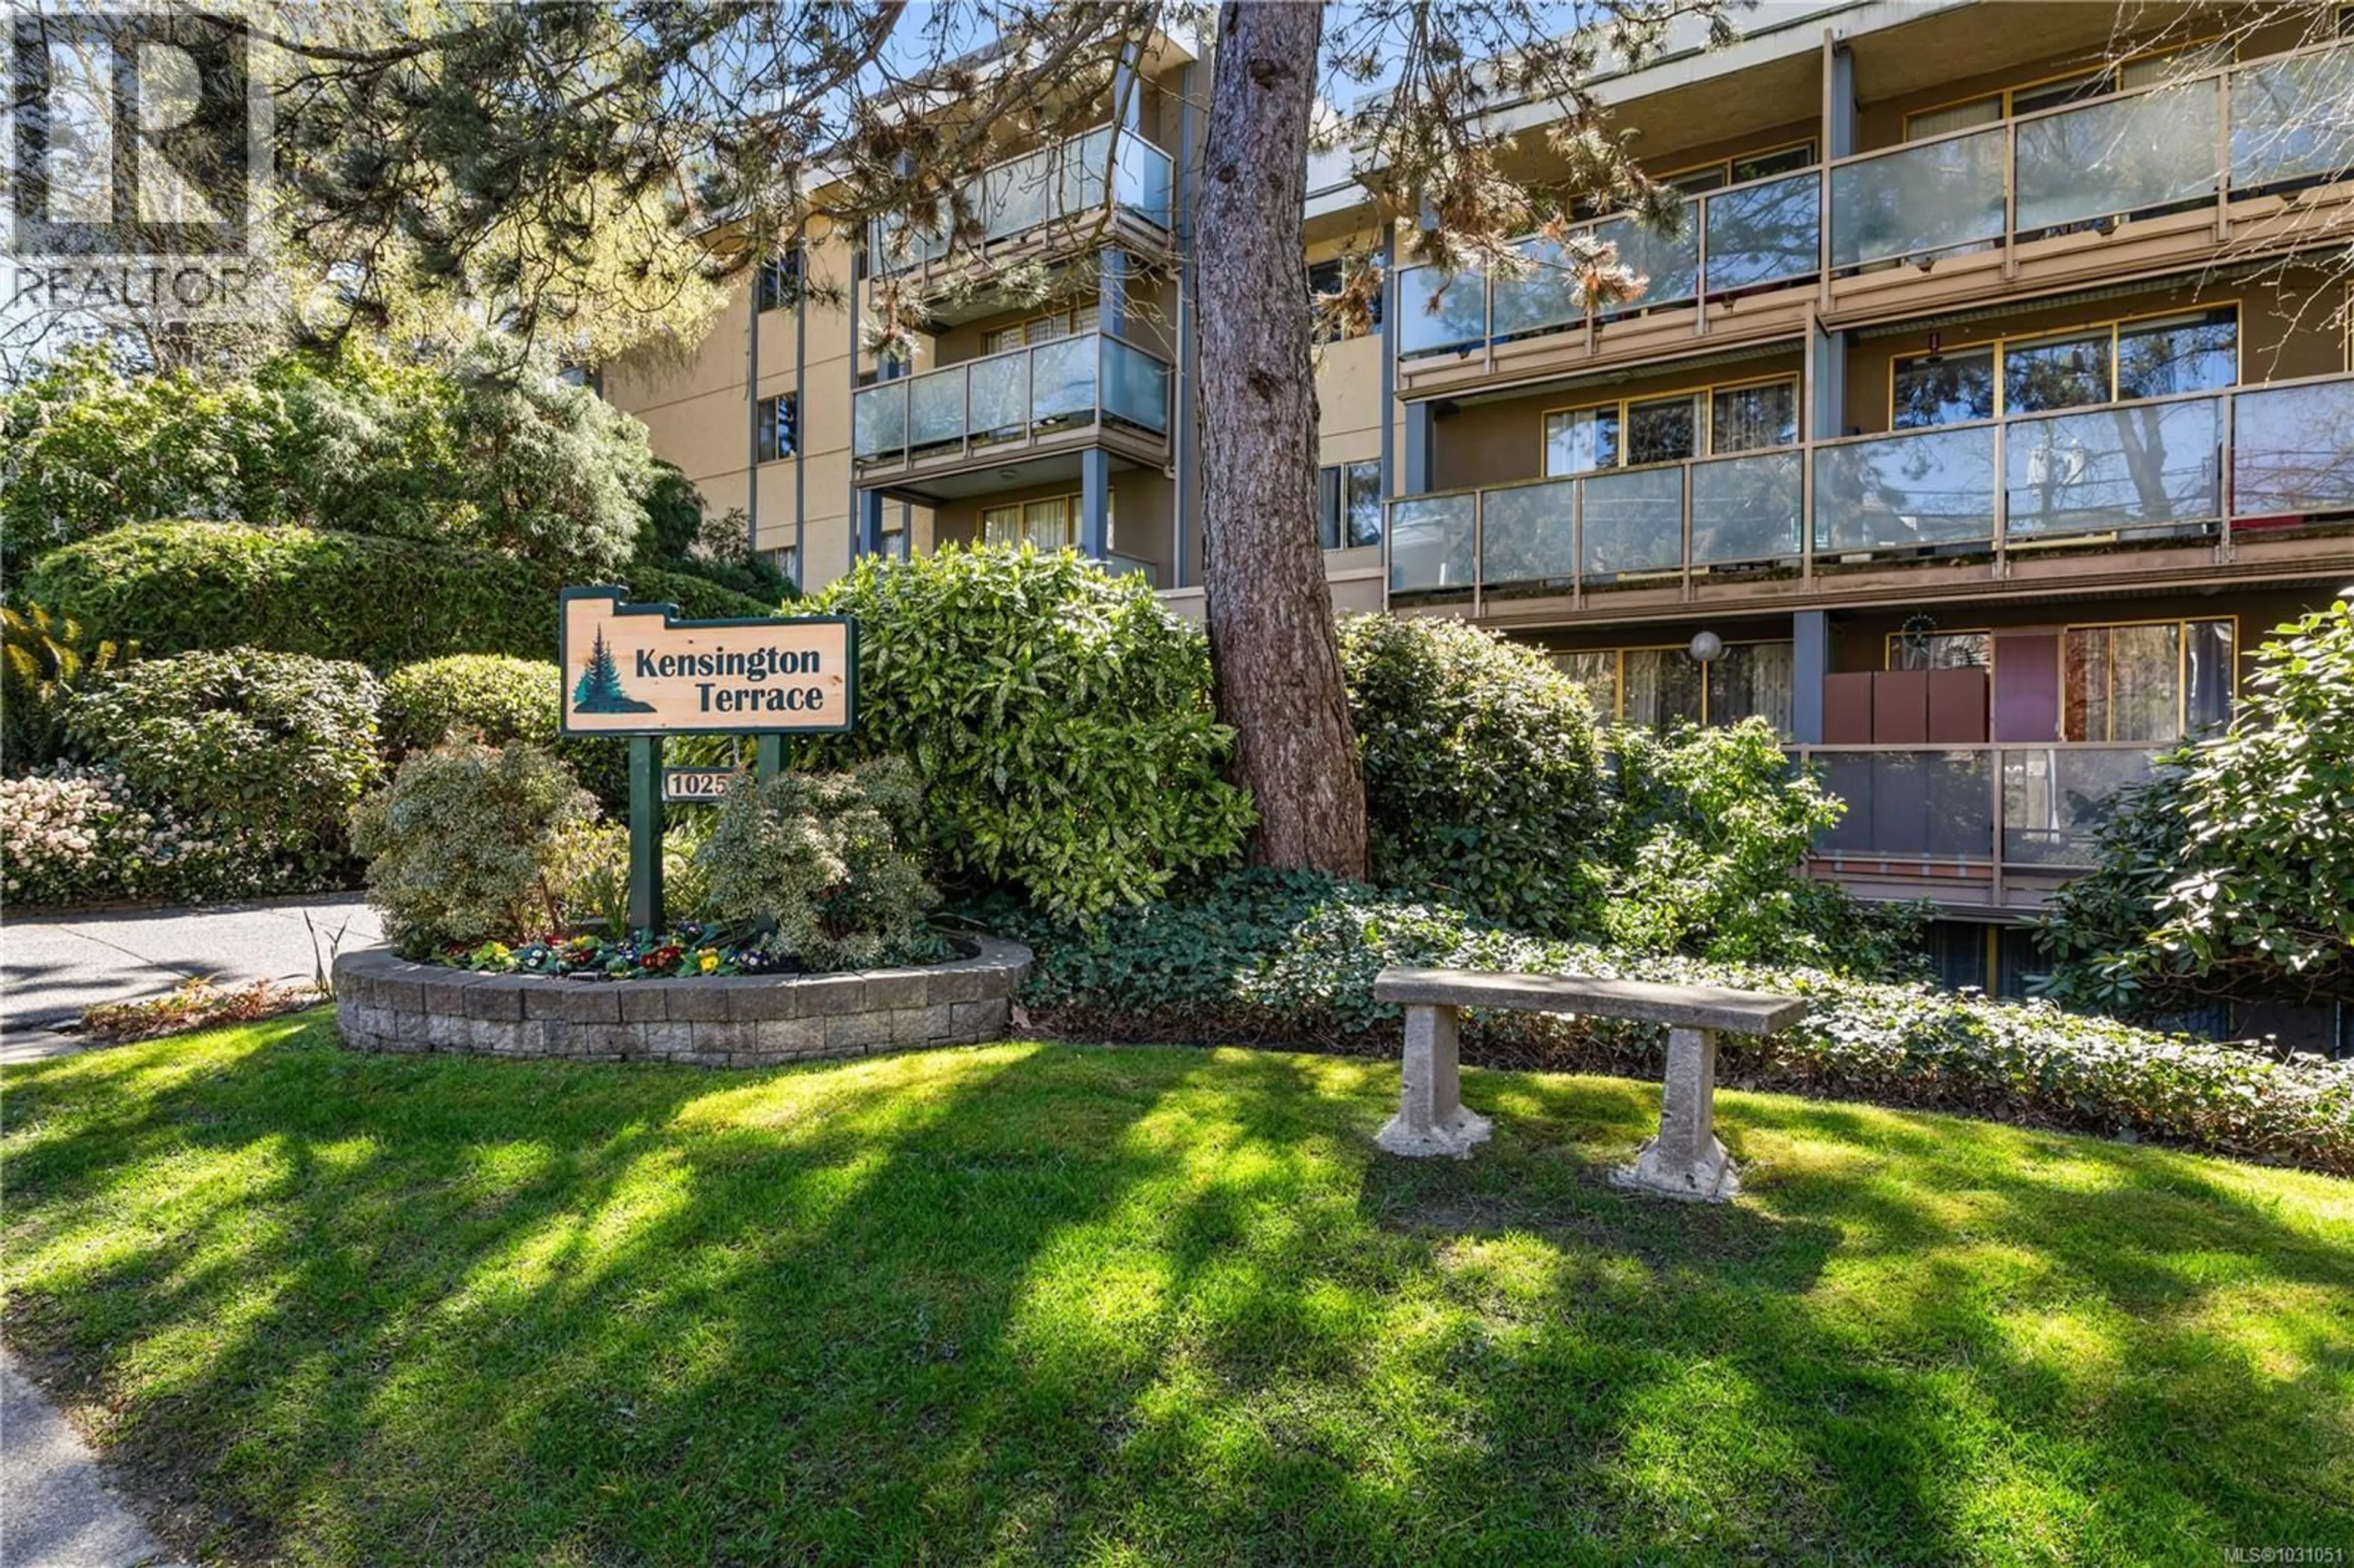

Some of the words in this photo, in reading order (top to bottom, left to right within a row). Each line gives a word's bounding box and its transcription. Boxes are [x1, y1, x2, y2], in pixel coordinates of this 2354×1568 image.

[636, 646, 820, 682] Kensington
[695, 682, 824, 712] Terrace
[672, 775, 728, 794] 1025
